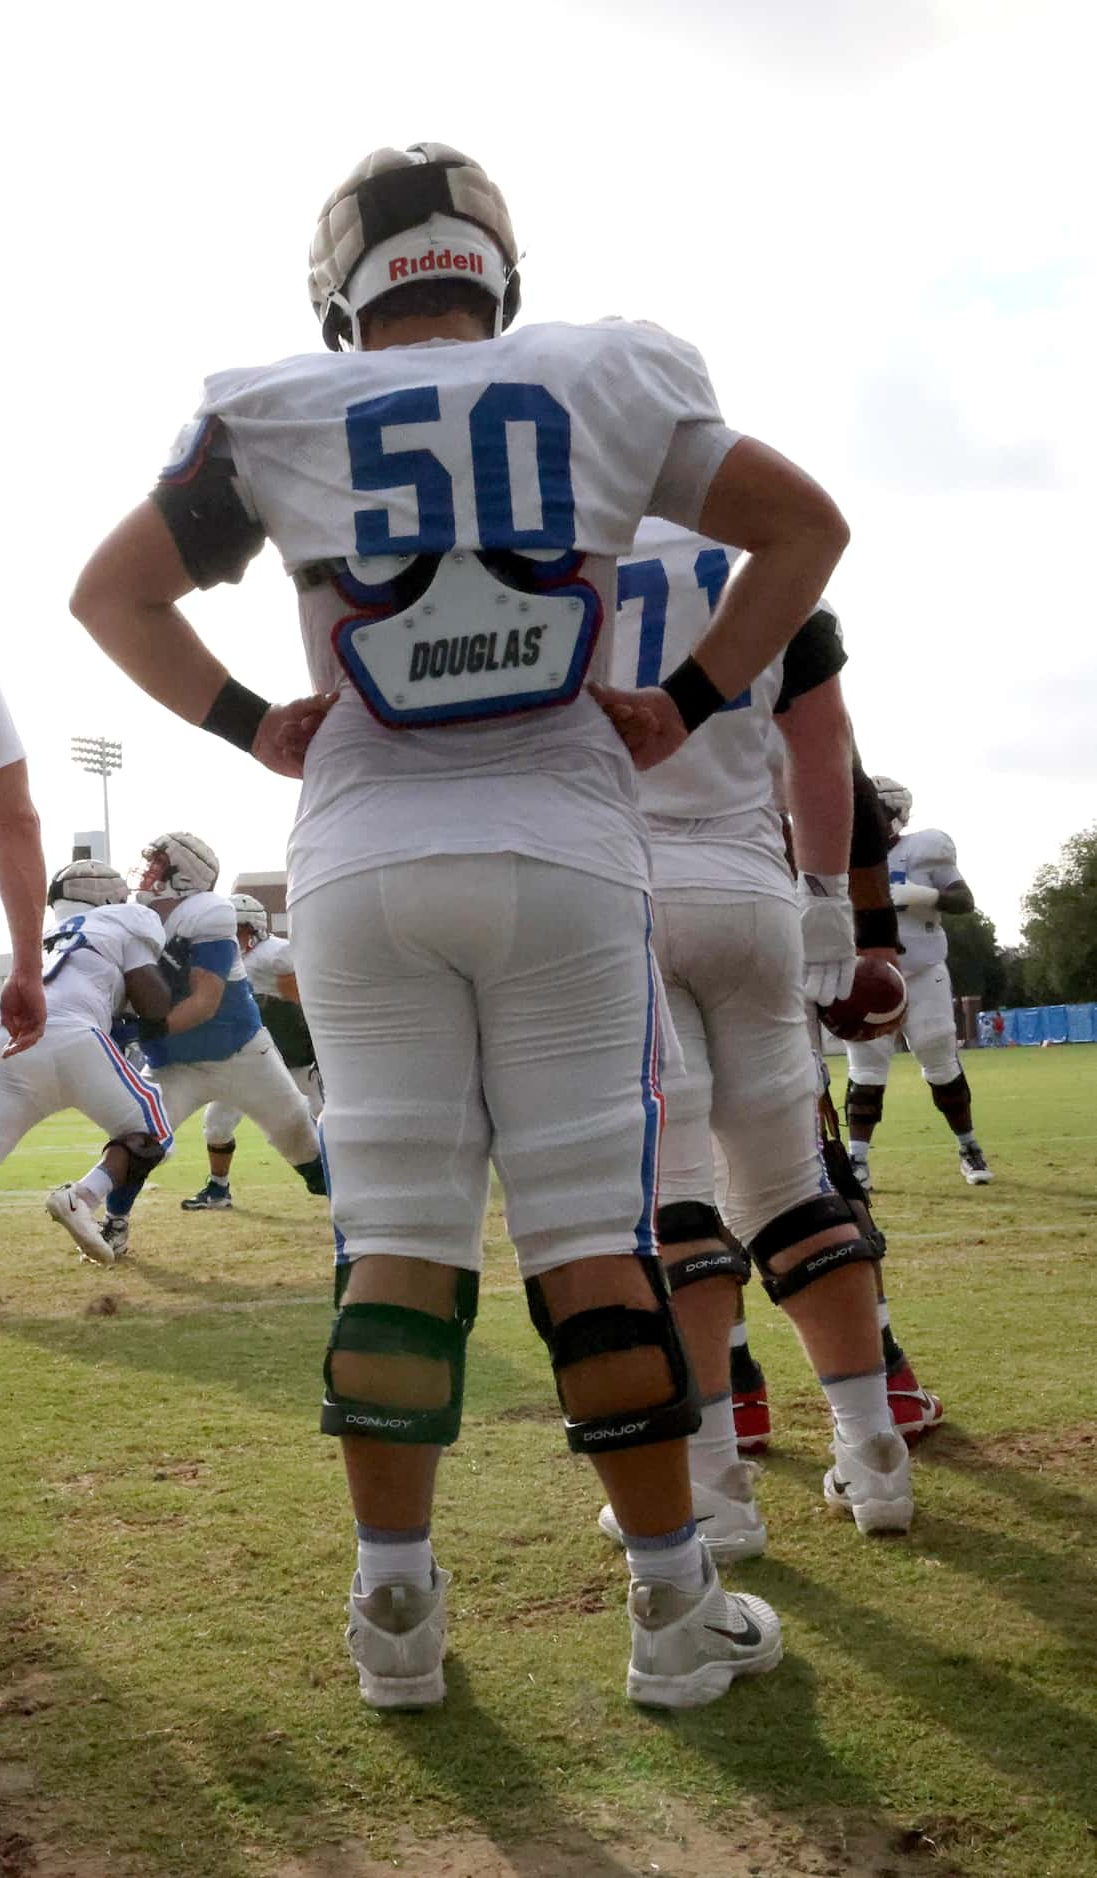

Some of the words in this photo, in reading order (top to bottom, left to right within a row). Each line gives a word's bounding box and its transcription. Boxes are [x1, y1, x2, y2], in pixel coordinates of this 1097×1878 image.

[389, 249, 483, 281] Riddell
[345, 383, 576, 556] 50
[408, 625, 543, 683] DOUGLAS
[686, 1256, 733, 1273] DONJOY
[806, 1246, 855, 1272] DONJOY
[345, 1414, 412, 1429] DONJOY
[583, 1421, 648, 1442] DONJOY
